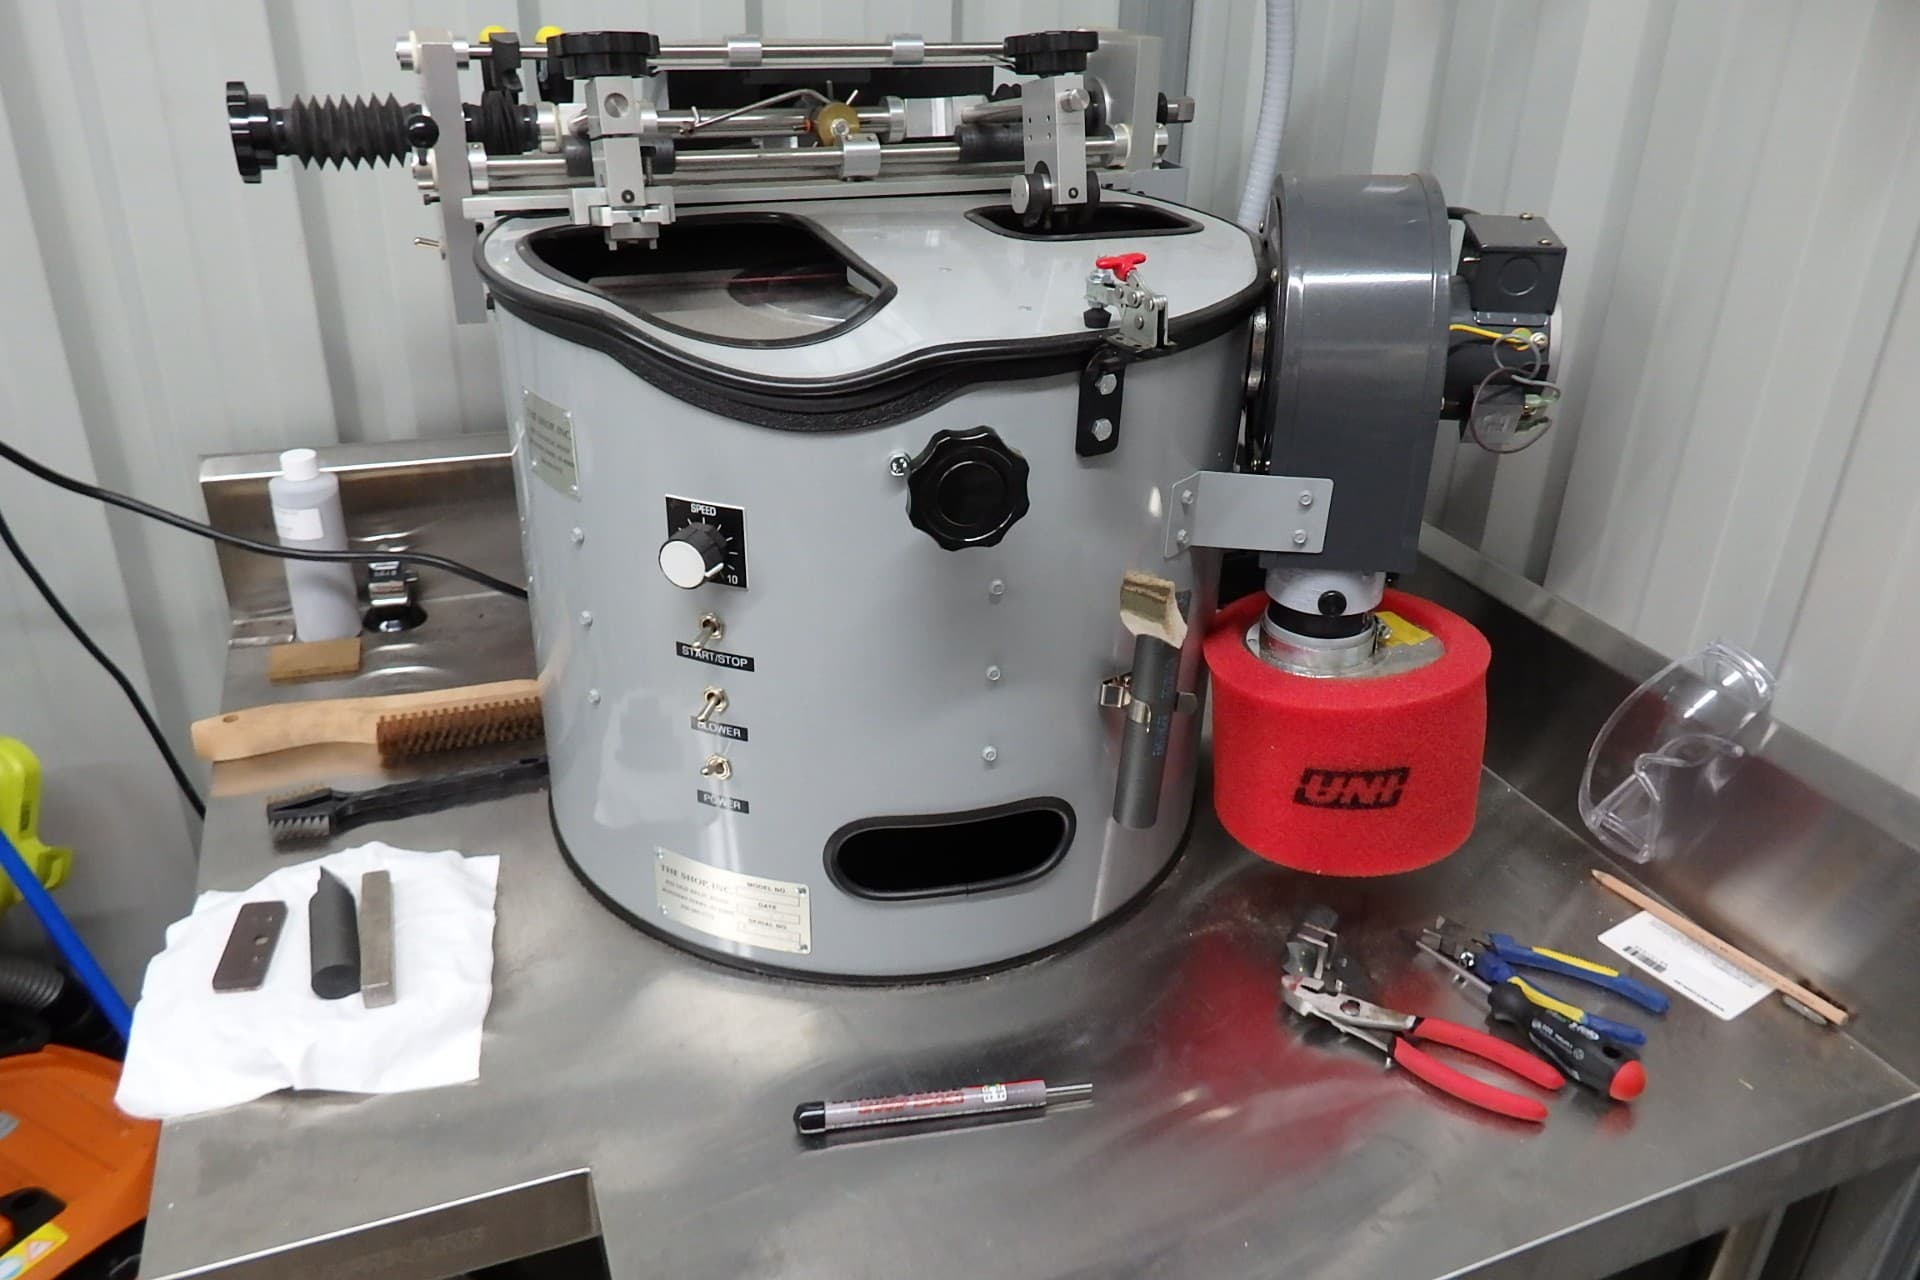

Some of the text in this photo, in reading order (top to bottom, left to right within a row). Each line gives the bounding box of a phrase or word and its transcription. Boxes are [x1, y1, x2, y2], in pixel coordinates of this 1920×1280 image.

[690, 503, 717, 517] SPEED
[727, 574, 739, 585] 10
[682, 645, 748, 667] START/STOP
[697, 721, 741, 738] BLOWER
[704, 793, 741, 810] POWER
